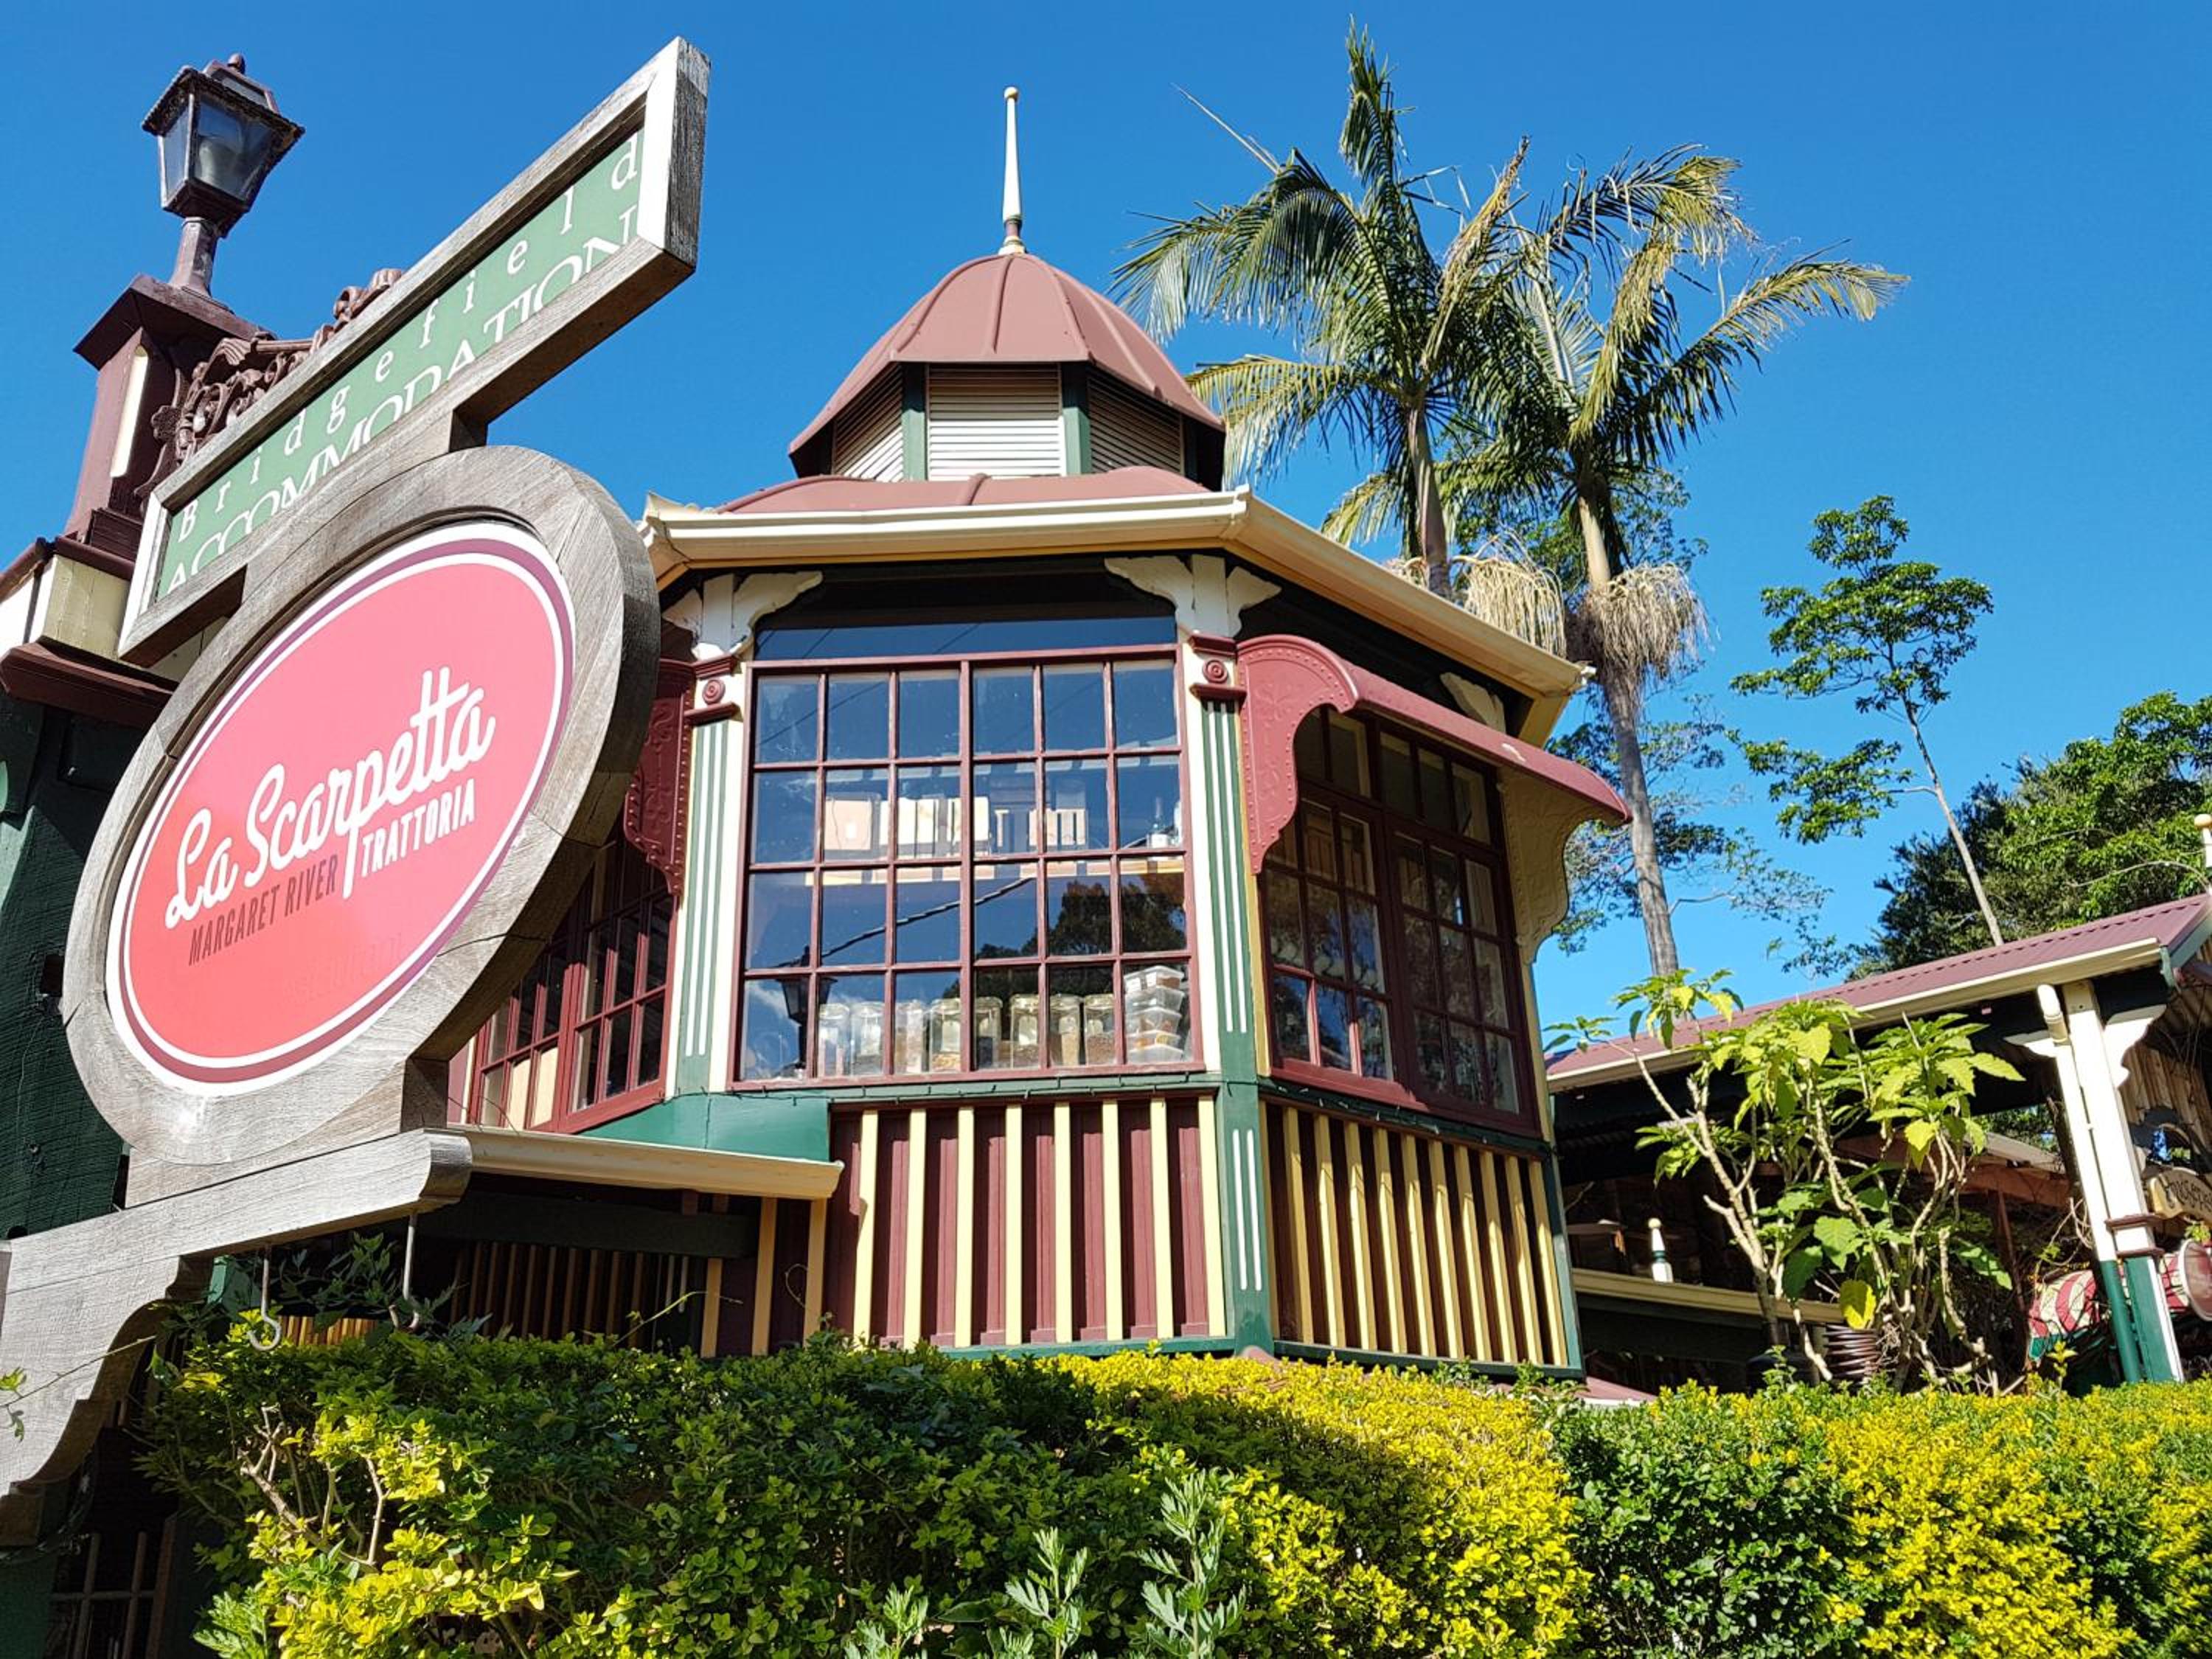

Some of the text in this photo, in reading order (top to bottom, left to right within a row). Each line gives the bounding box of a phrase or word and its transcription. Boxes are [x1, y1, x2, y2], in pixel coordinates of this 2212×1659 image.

[165, 666, 495, 929] La Scarpetta
[189, 885, 280, 966] MARGARET
[285, 854, 338, 917] RIVER
[362, 779, 474, 878] TRATTORIA
